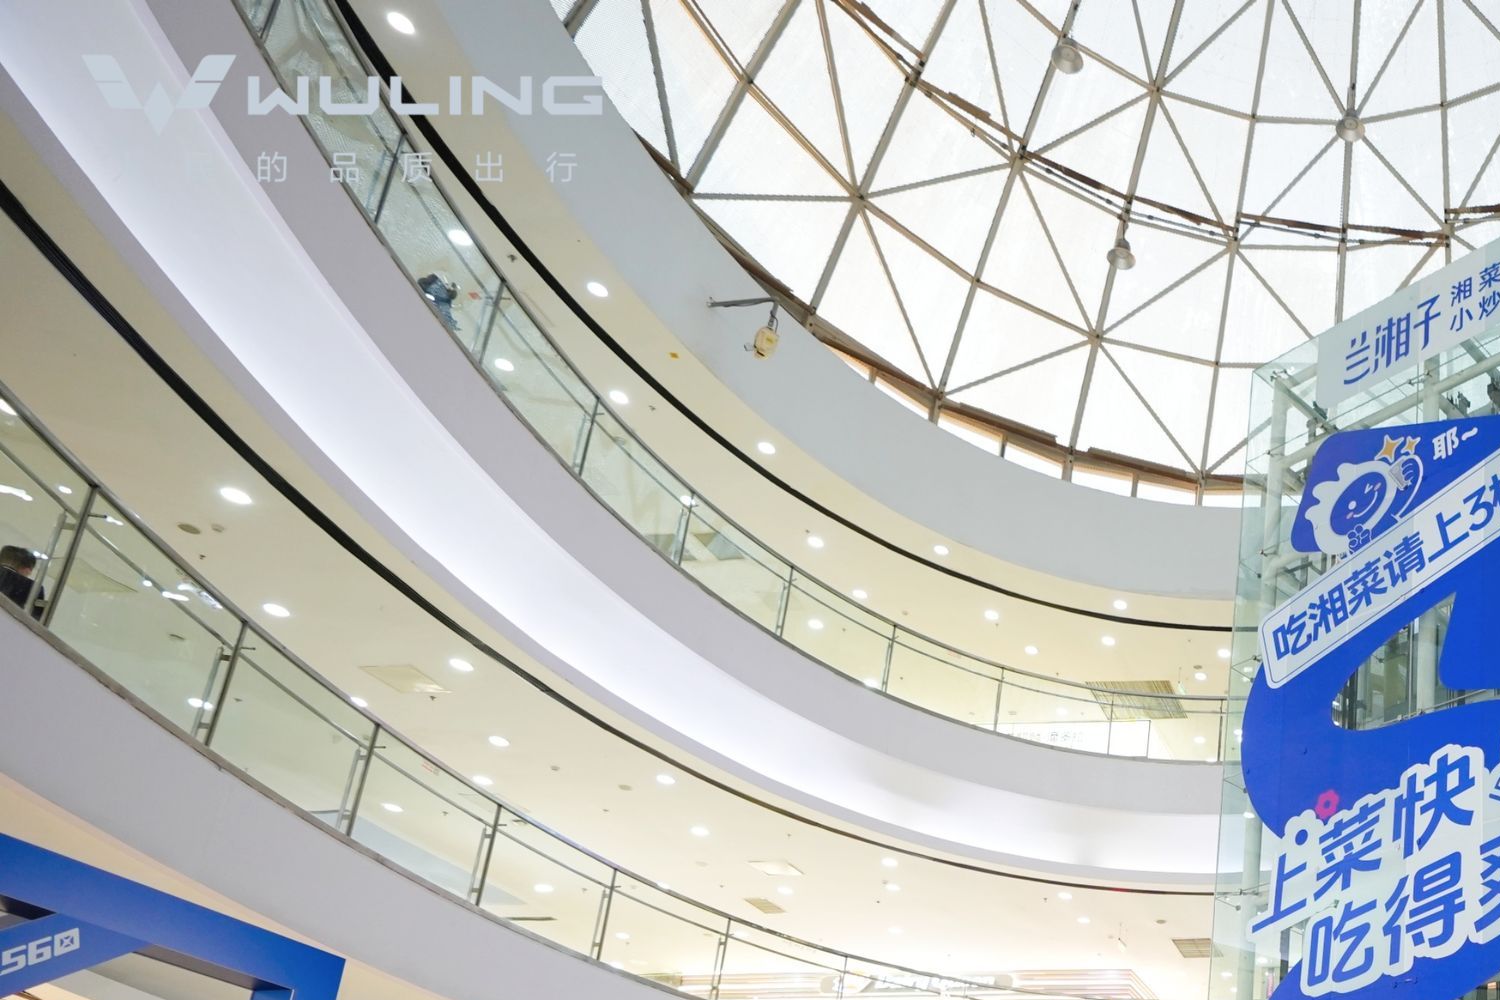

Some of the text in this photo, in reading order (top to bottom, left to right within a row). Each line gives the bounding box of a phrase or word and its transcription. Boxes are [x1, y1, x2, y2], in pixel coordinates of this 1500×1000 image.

[1342, 294, 1442, 385] 兰湘子
[1251, 751, 1476, 936] 上菜快
[0, 927, 80, 976] 560
